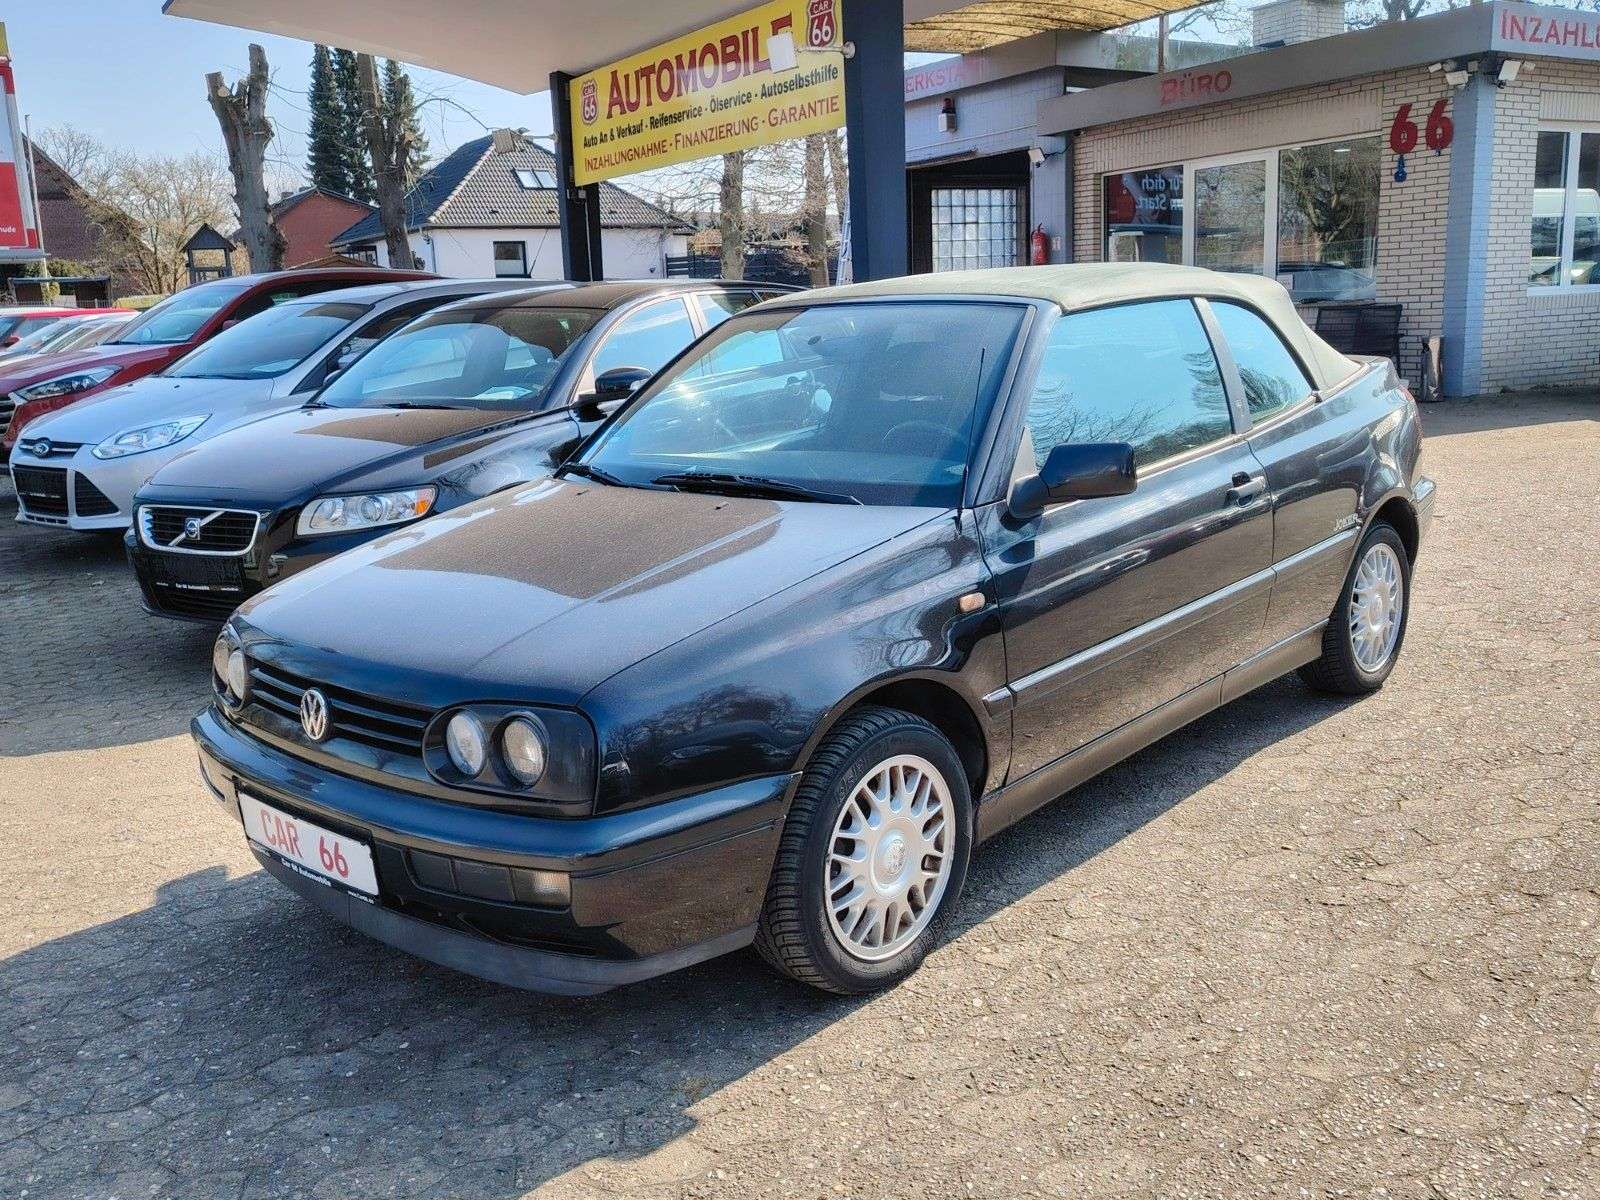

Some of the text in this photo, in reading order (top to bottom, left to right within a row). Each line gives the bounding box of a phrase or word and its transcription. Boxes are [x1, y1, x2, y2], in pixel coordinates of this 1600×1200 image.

[813, 1, 829, 14] CAR
[812, 16, 832, 46] 66
[583, 135, 598, 149] Auto
[600, 131, 608, 144] An
[616, 119, 644, 139] Verkauf
[650, 105, 703, 130] Reifenservice
[710, 91, 752, 114] Ölservice
[760, 64, 839, 99] Autoselbsthilfe
[584, 96, 597, 119] 66
[1389, 99, 1454, 154] 66
[260, 808, 349, 878] CAR 66
